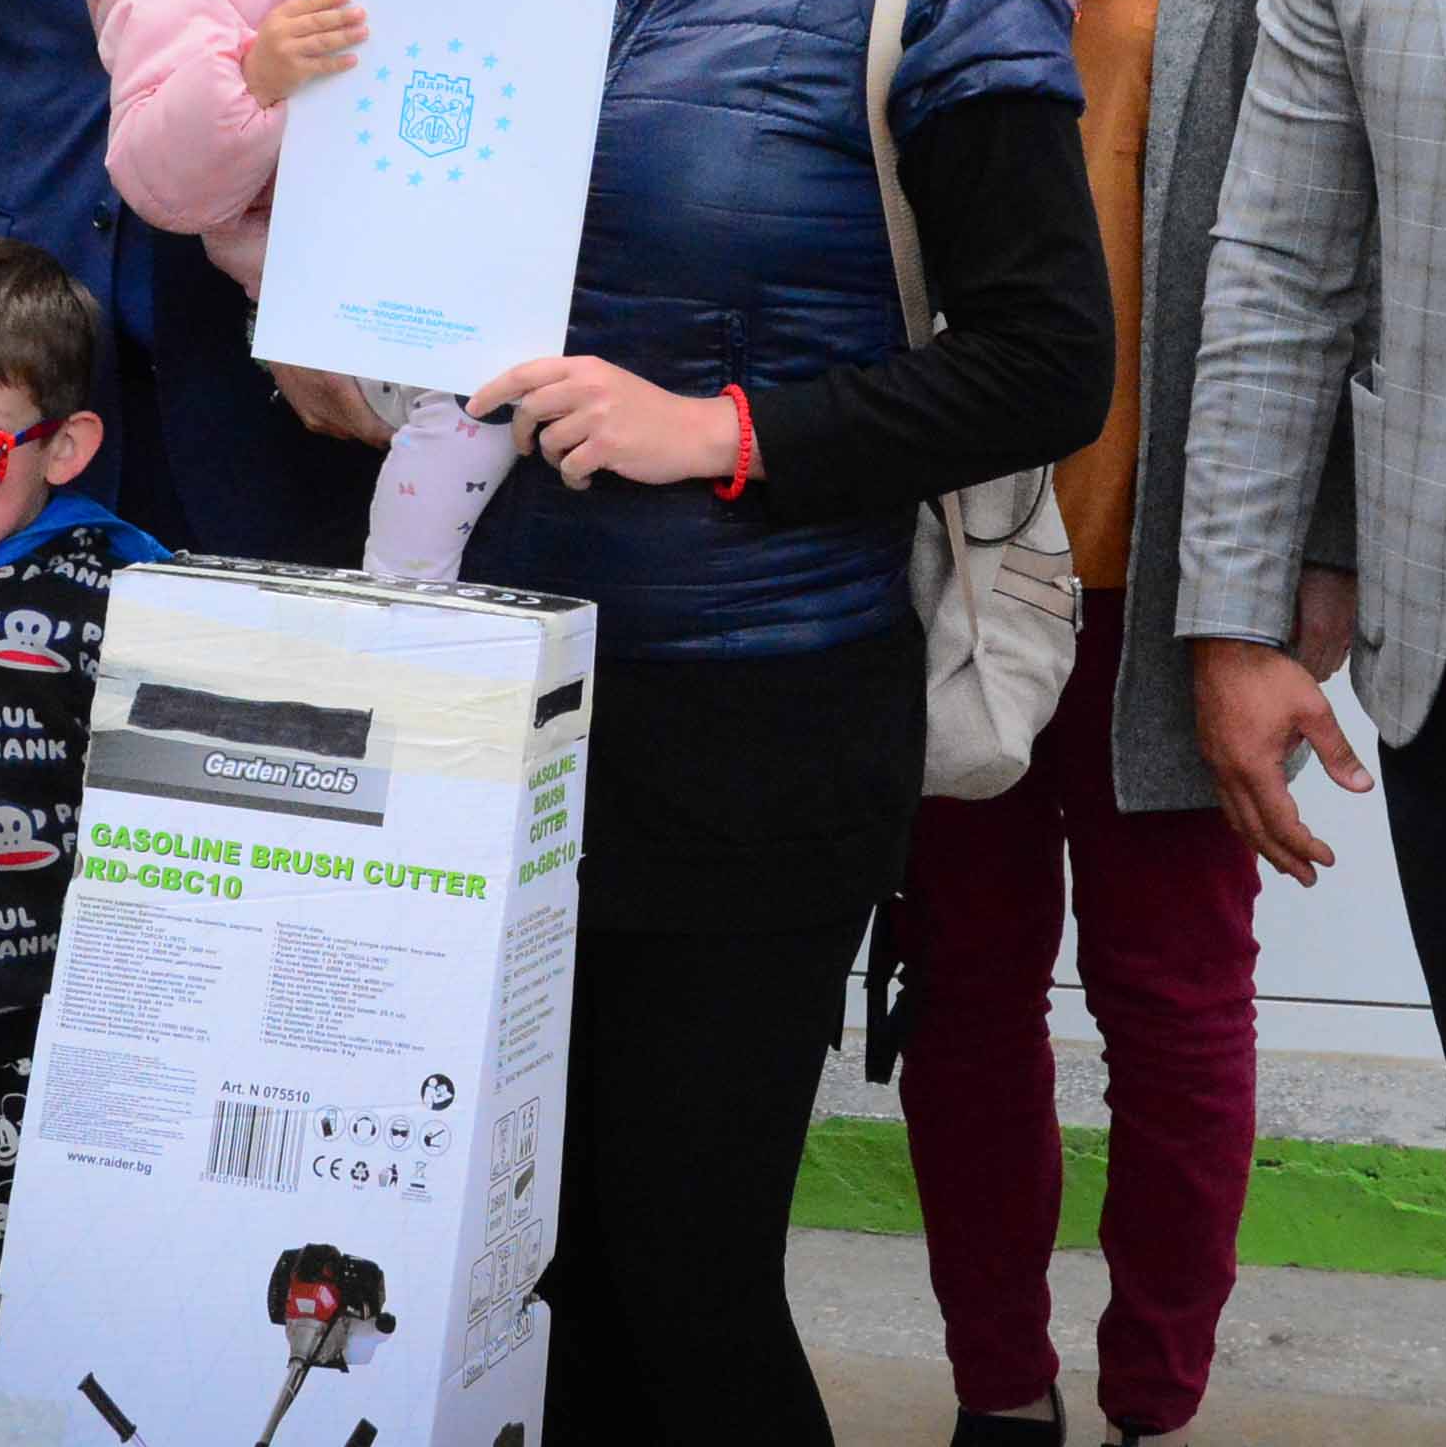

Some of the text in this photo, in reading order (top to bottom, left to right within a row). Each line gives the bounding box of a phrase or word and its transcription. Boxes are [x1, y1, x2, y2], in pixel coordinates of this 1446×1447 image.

[203, 752, 358, 795] Garden Tools
[528, 753, 577, 792] GASOLINE
[533, 783, 566, 815] BRUSH
[529, 808, 569, 844] CUTTER
[84, 855, 243, 900] RD-GBC10
[90, 822, 243, 866] GASOLINE
[251, 843, 355, 882] BRUSH
[361, 864, 487, 900] CUTTER
[518, 839, 577, 888] RD-GBC10
[221, 1080, 311, 1104] Art. N 075510
[66, 1151, 153, 1176] www.raider.bg
